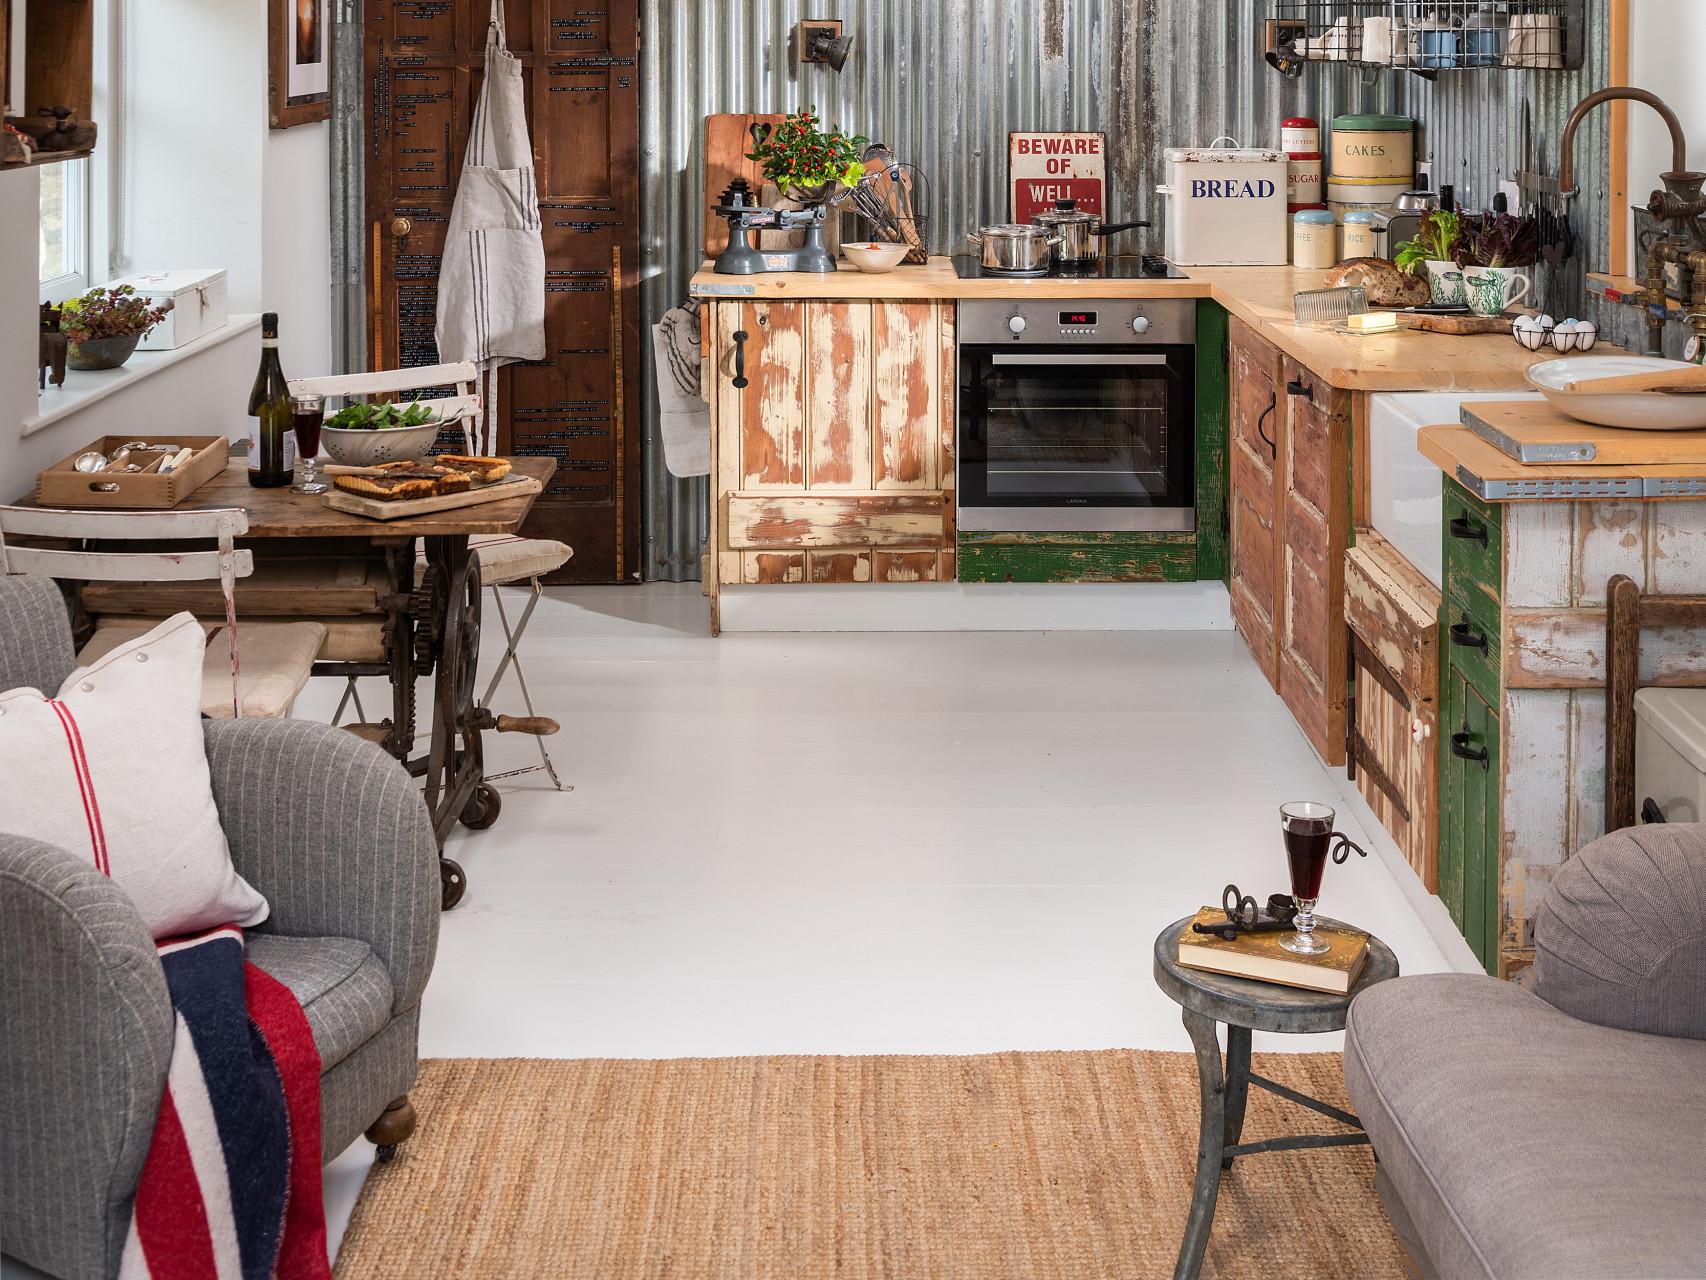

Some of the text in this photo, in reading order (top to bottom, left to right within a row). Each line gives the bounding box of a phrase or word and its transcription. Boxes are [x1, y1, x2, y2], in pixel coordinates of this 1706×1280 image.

[1018, 139, 1099, 154] BEWARE
[1345, 144, 1385, 156] CAKES
[1046, 158, 1071, 174] OF
[1288, 174, 1319, 183] SUGAR
[1191, 179, 1275, 198] BREAD
[1347, 234, 1365, 243] RICE
